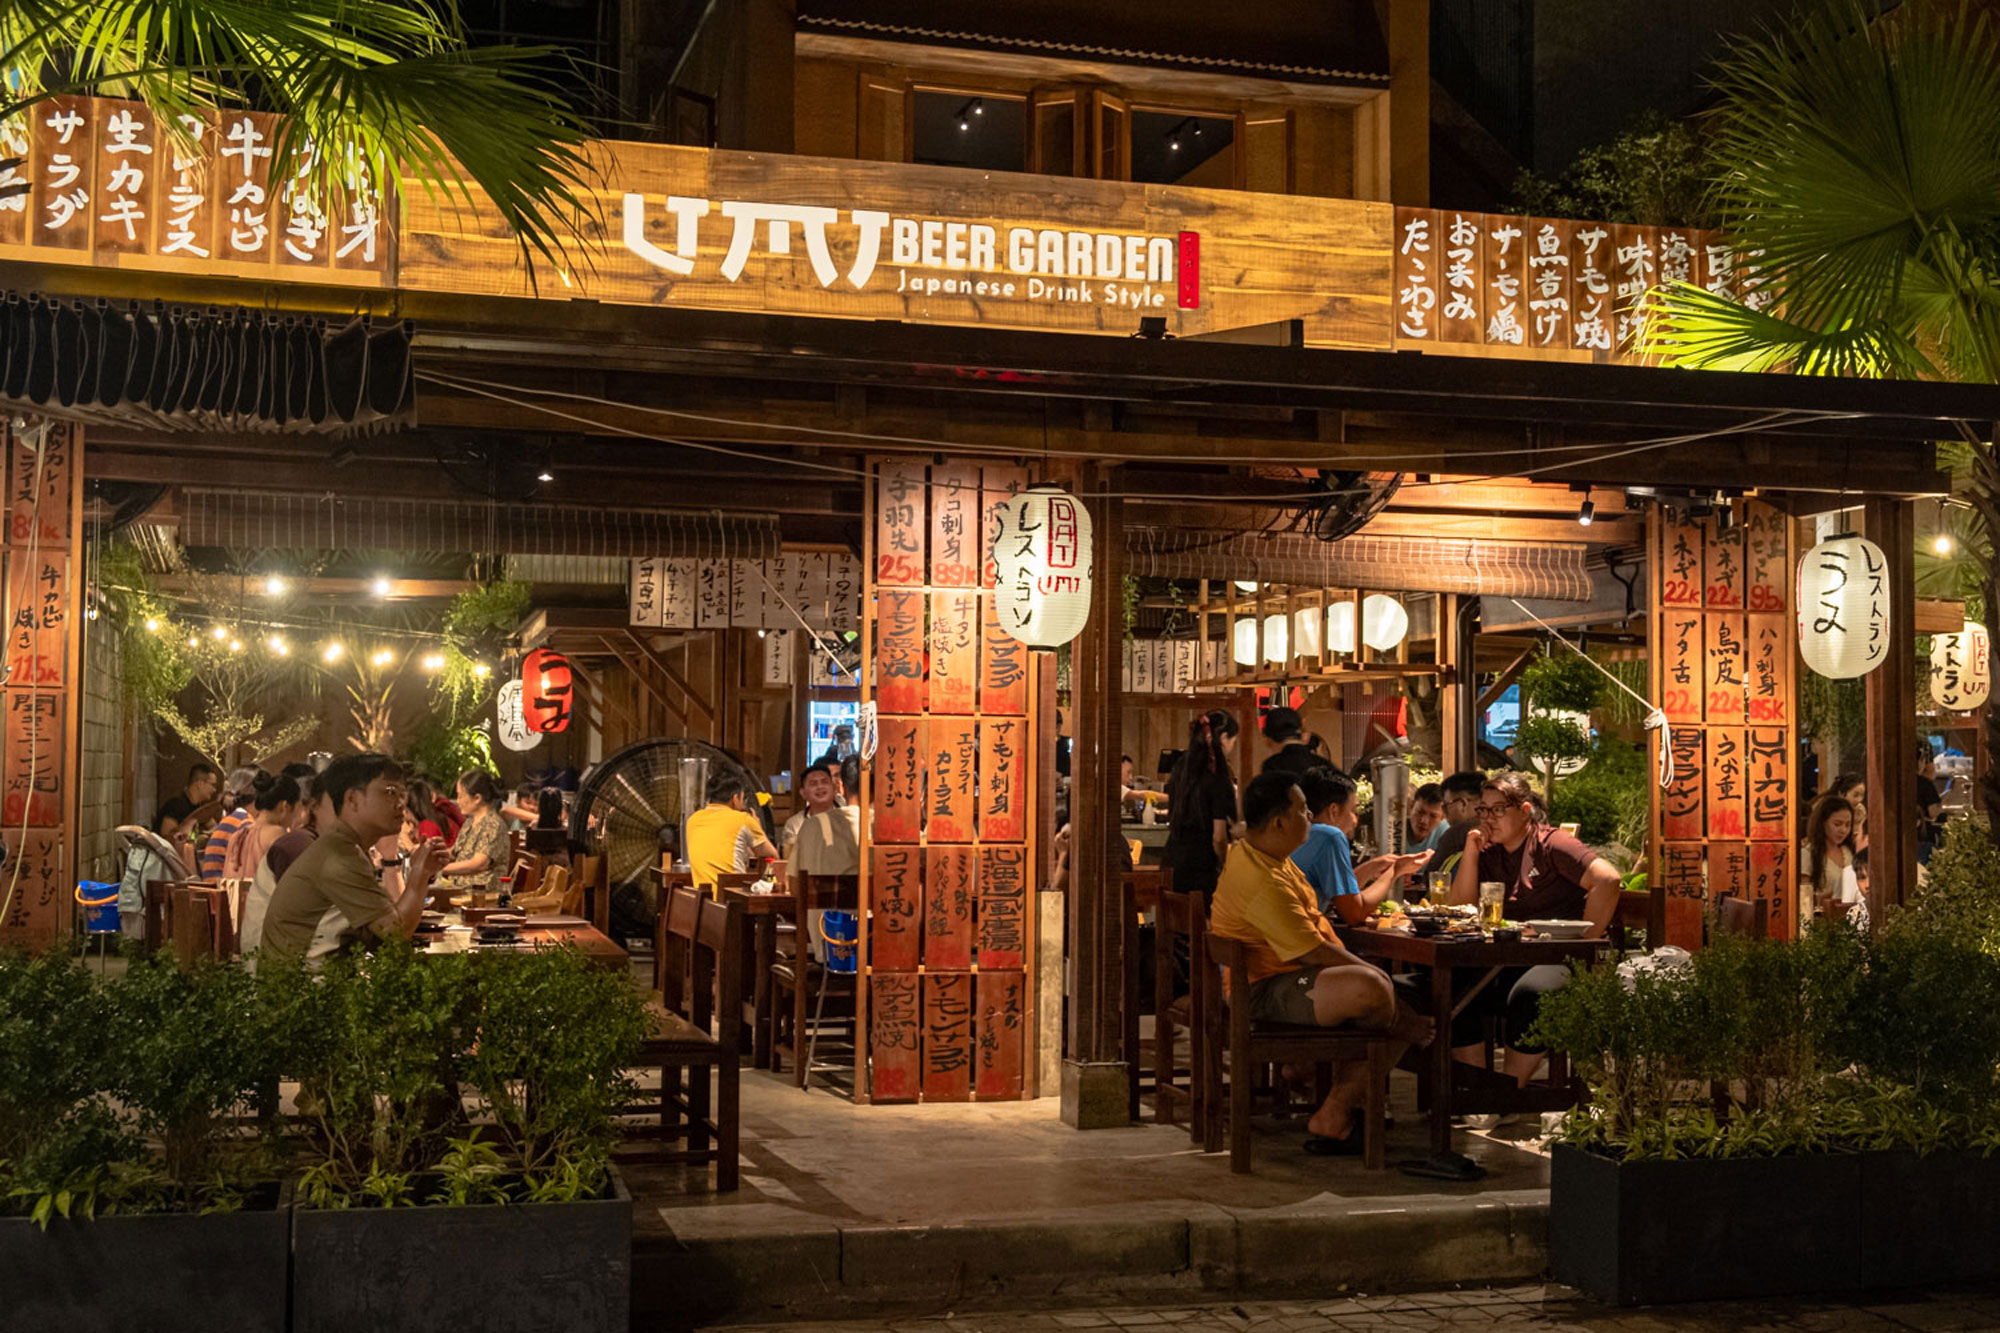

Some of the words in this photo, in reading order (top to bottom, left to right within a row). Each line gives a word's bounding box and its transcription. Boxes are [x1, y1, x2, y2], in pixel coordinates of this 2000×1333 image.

[44, 109, 90, 230] サラダ
[100, 109, 153, 241] 生カキ
[221, 116, 273, 253] 牛カルビ
[892, 218, 997, 271] BEER
[1009, 227, 1173, 284] GARDEN
[898, 269, 1016, 298] Japanese
[1028, 279, 1093, 304] Drink
[1104, 283, 1166, 309] Style
[1400, 217, 1436, 338] たこわさ
[1487, 223, 1524, 345] サーモン鍋
[884, 471, 920, 552] 手羽先
[940, 478, 964, 564] タコ刺身
[1860, 543, 1885, 661] レストラン
[1670, 619, 1698, 685] ブタ舌
[1709, 621, 1743, 686] 鳥皮
[885, 745, 903, 808] ソーセージ
[903, 728, 918, 801] イタリアン
[956, 732, 974, 796] エビフライ
[987, 720, 1016, 816] サーモン刺身
[1713, 732, 1742, 802] うな重
